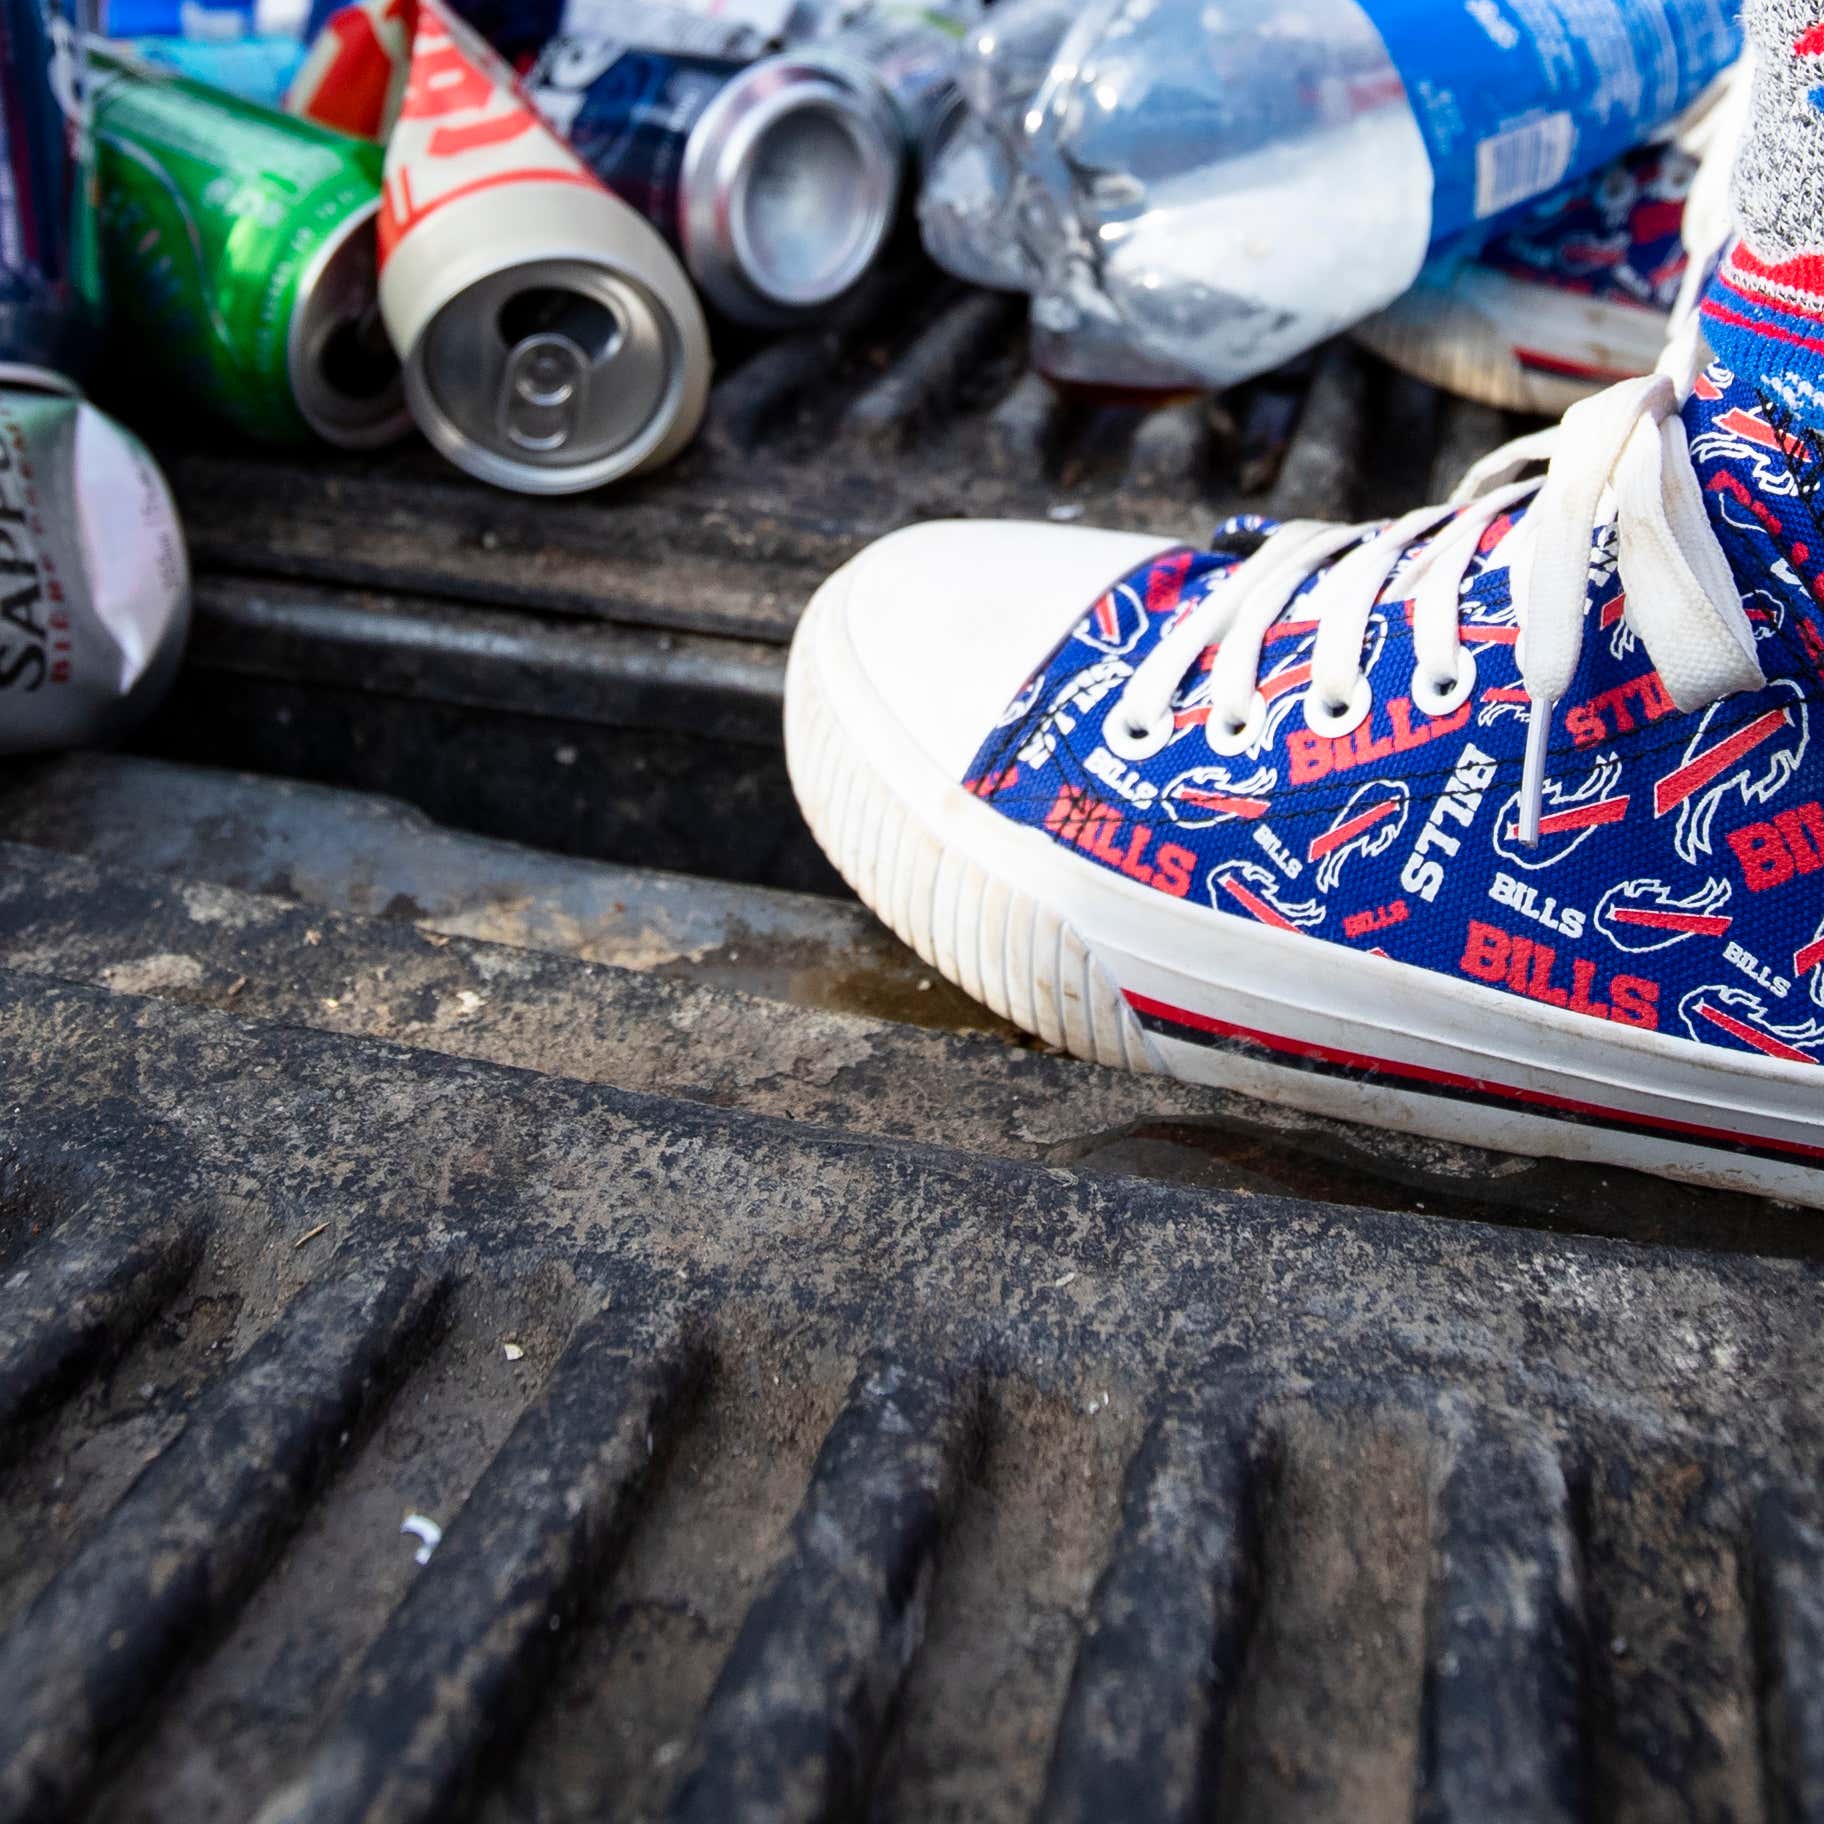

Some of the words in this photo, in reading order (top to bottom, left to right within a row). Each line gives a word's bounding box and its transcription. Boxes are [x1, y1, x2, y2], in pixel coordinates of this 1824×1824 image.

[1083, 746, 1159, 811] BILLS
[1044, 783, 1198, 898] BILLS
[1253, 824, 1304, 879] BILLS
[1400, 742, 1498, 903] BILLS
[1342, 900, 1411, 939] BILLS
[1488, 872, 1586, 940] BILLS
[1460, 919, 1661, 1033] BILLS
[1722, 941, 1793, 999] BILLS
